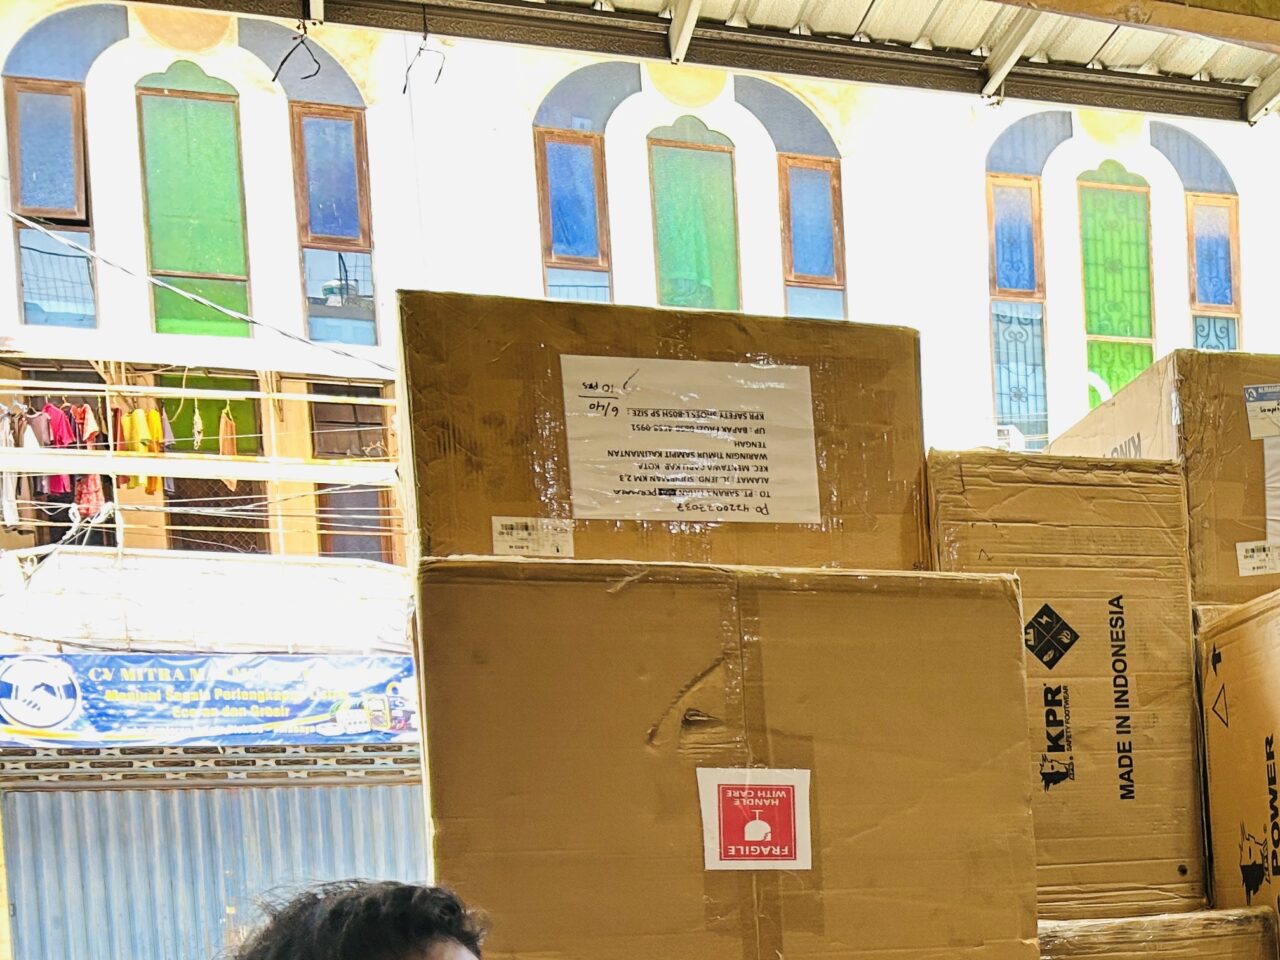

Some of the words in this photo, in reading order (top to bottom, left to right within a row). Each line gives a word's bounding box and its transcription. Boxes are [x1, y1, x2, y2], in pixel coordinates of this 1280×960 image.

[720, 412, 748, 420] SAFETY
[721, 426, 748, 434] BAPAK
[608, 450, 662, 458] KALIMANTAN
[726, 452, 768, 460] WARINGIN
[736, 476, 769, 484] ALAMAT
[760, 490, 770, 498] TO
[1108, 594, 1130, 708] INDONESIA
[88, 668, 116, 682] CV
[120, 668, 187, 682] MITRA
[1062, 685, 1070, 724] FOOTWEAR
[1044, 684, 1066, 752] KPR
[1116, 716, 1132, 735] IN
[1064, 724, 1072, 752] SAFETY
[1117, 740, 1136, 800] MADE
[726, 790, 754, 798] CARE
[758, 790, 786, 798] WITH
[734, 798, 779, 806] HANDLE
[728, 846, 789, 855] FRAGILE
